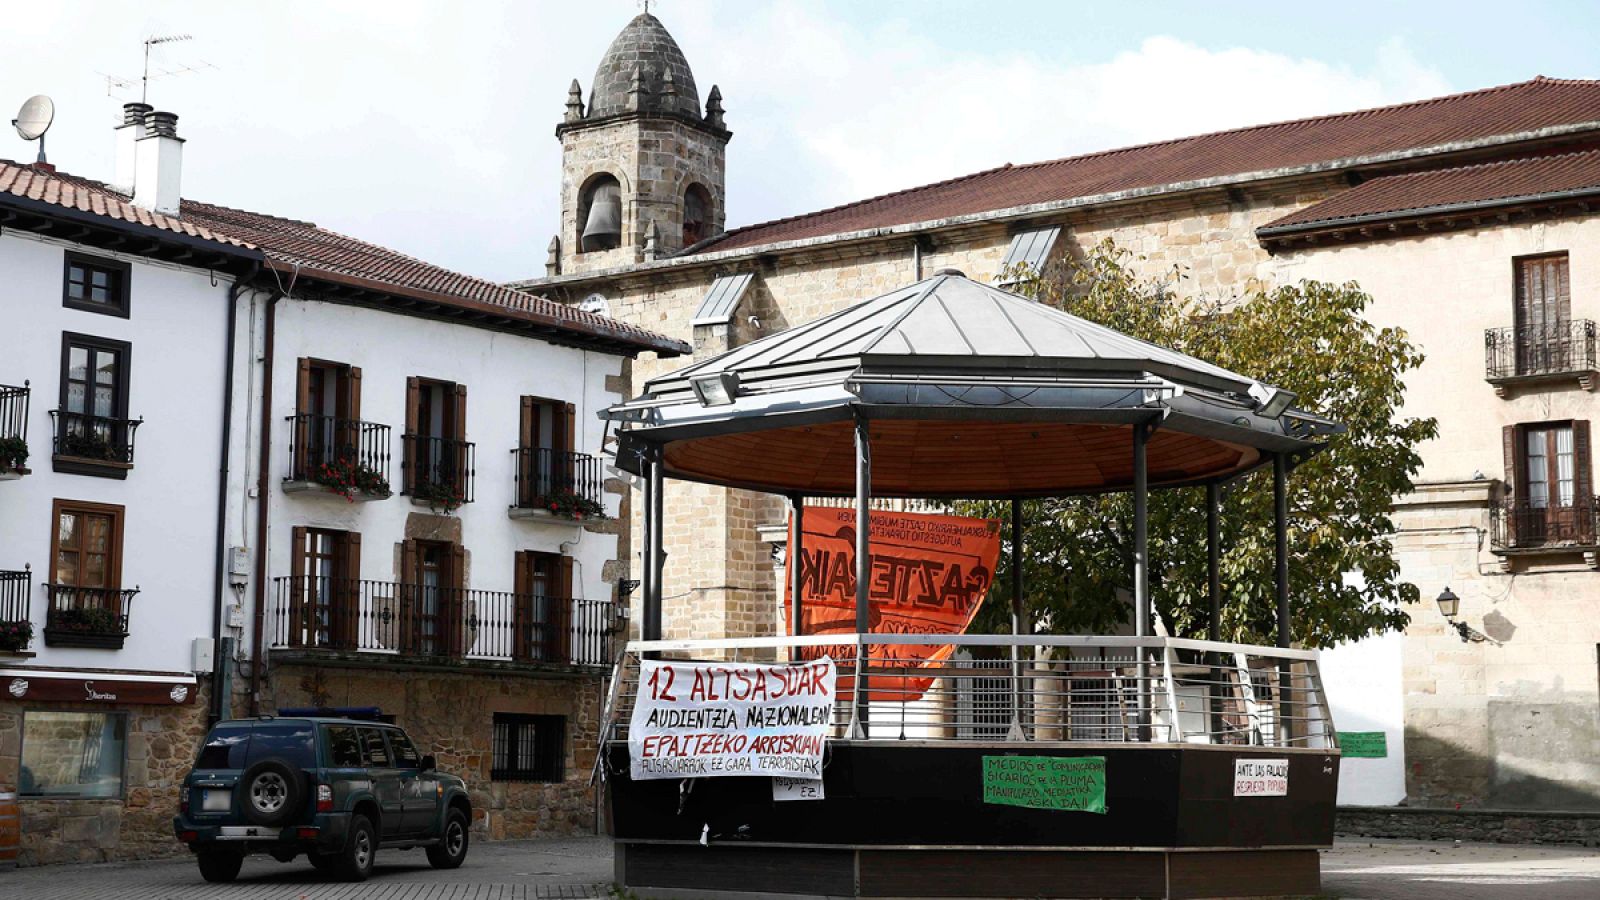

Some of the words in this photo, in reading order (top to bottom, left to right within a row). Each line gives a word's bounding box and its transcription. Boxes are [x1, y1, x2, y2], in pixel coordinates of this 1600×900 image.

[648, 665, 676, 701] 12
[690, 663, 830, 701] ALTSASUAR
[646, 708, 738, 729] AUDIENTZIA
[746, 704, 832, 729] NAZIONALEAN
[642, 734, 748, 757] EPAITZEKO
[748, 733, 824, 756] ARRISKUAN
[711, 757, 723, 771] EZ
[725, 757, 752, 771] GARA
[758, 756, 820, 775] TERRORISTAK
[988, 759, 1034, 772] MEDIOS
[1237, 763, 1253, 777] ANTE
[1255, 763, 1265, 777] LAS
[987, 772, 1037, 786] SICARIOS
[1060, 775, 1097, 786] PLUMA
[1026, 798, 1054, 808] ASKI
